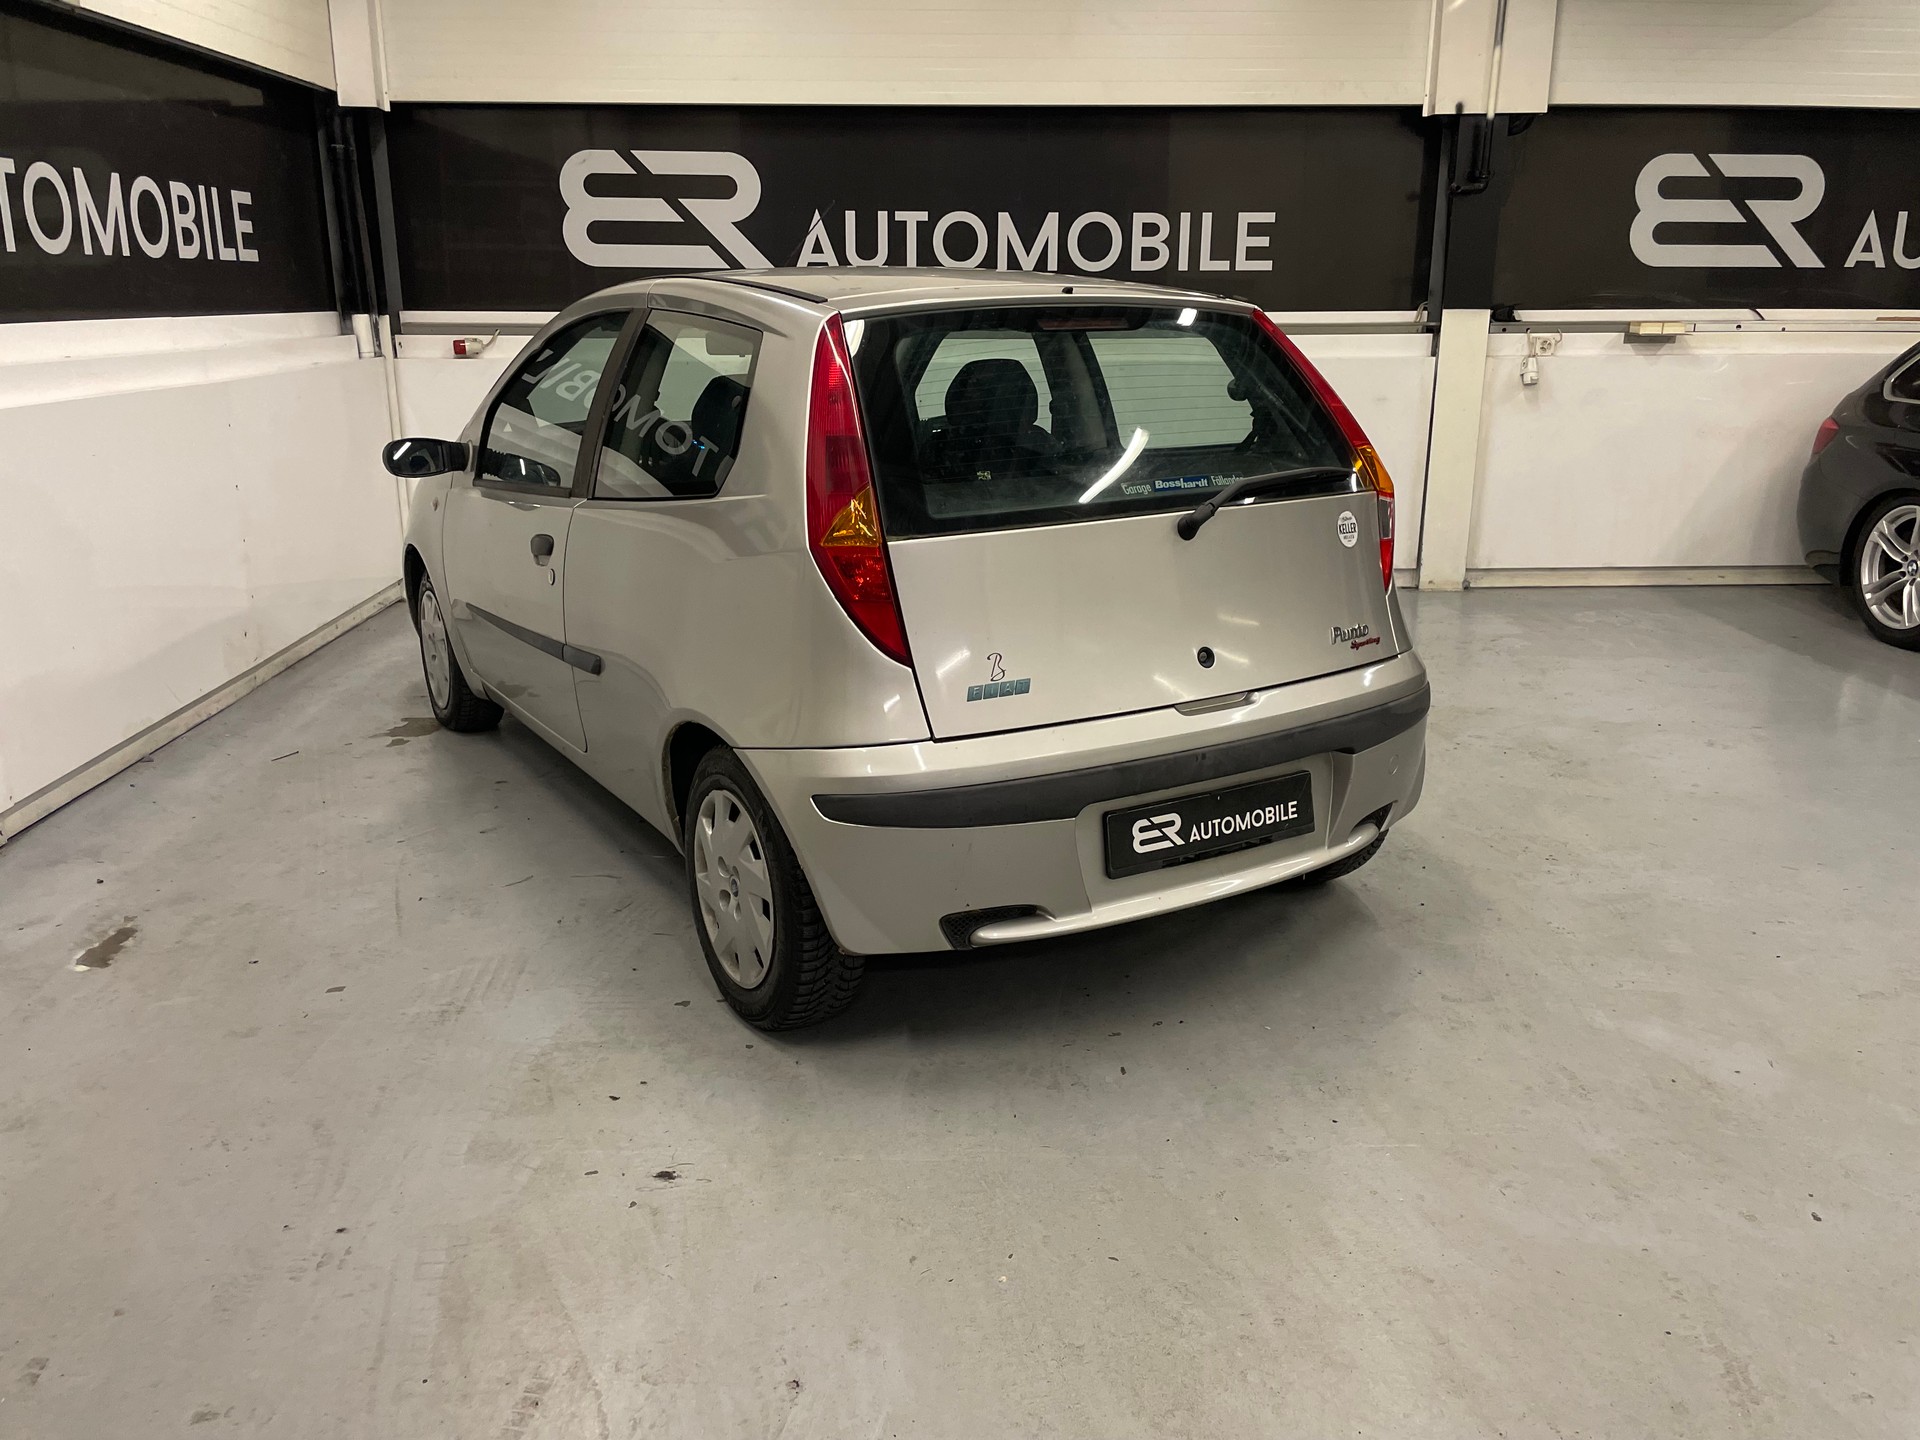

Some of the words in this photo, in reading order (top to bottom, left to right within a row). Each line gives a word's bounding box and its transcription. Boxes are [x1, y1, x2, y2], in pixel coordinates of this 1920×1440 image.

[0, 157, 259, 262] TOMOBILE
[796, 208, 1277, 272] AUTOMOBILE
[1120, 482, 1152, 495] Garage
[1155, 478, 1209, 489] Bosshardt
[1339, 522, 1357, 535] KELLER
[1330, 624, 1369, 645] Punto
[969, 679, 1030, 701] FIAT
[1189, 800, 1298, 843] AUTOMOBILE
